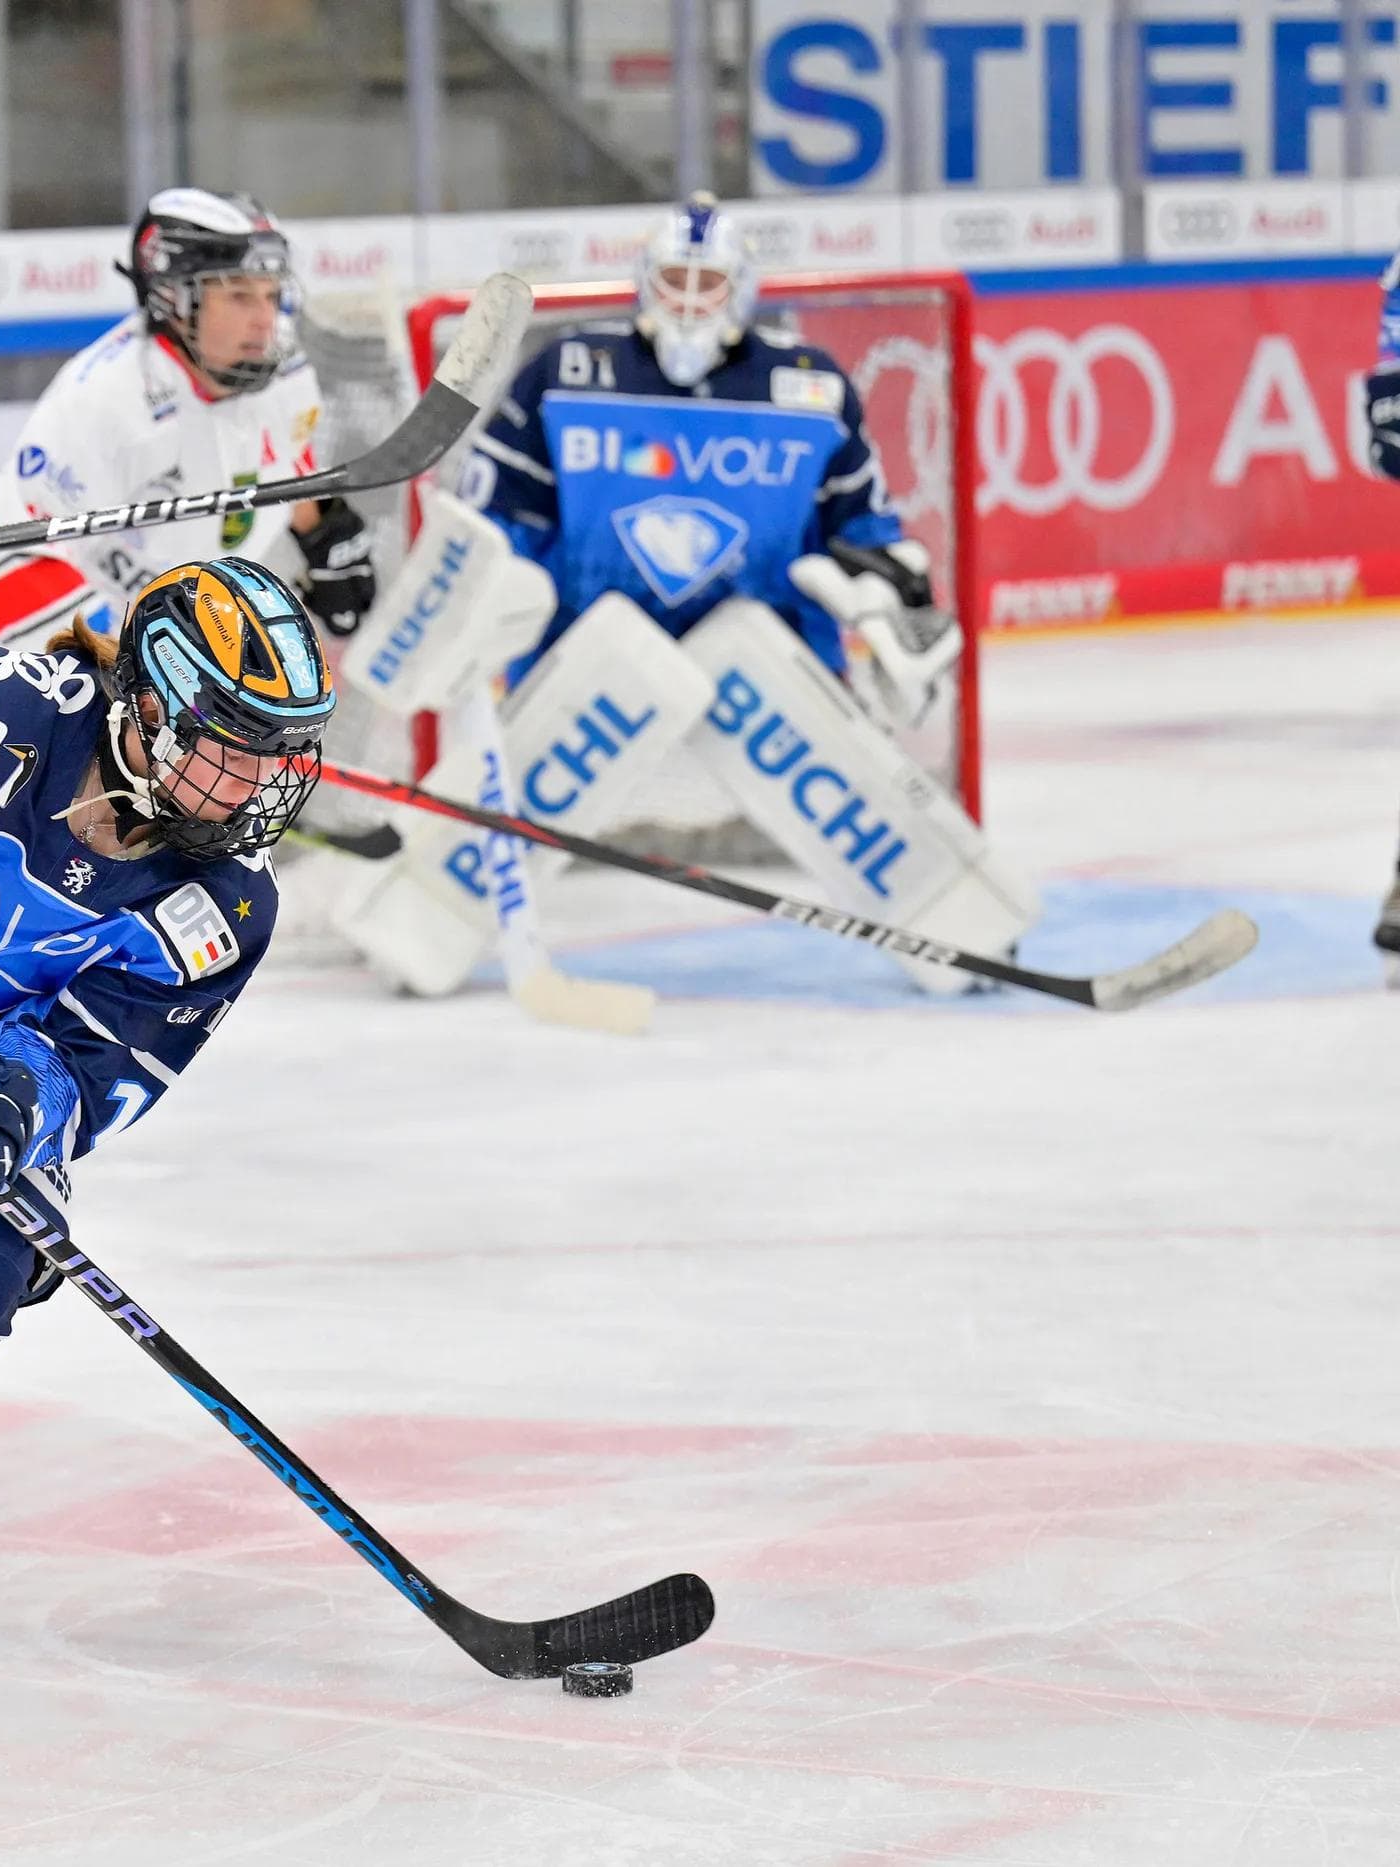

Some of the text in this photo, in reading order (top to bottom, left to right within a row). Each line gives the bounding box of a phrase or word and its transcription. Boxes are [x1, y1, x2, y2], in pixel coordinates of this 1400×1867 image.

[21, 260, 100, 292] Audi
[677, 434, 813, 487] VOLT
[200, 593, 232, 644] Continental
